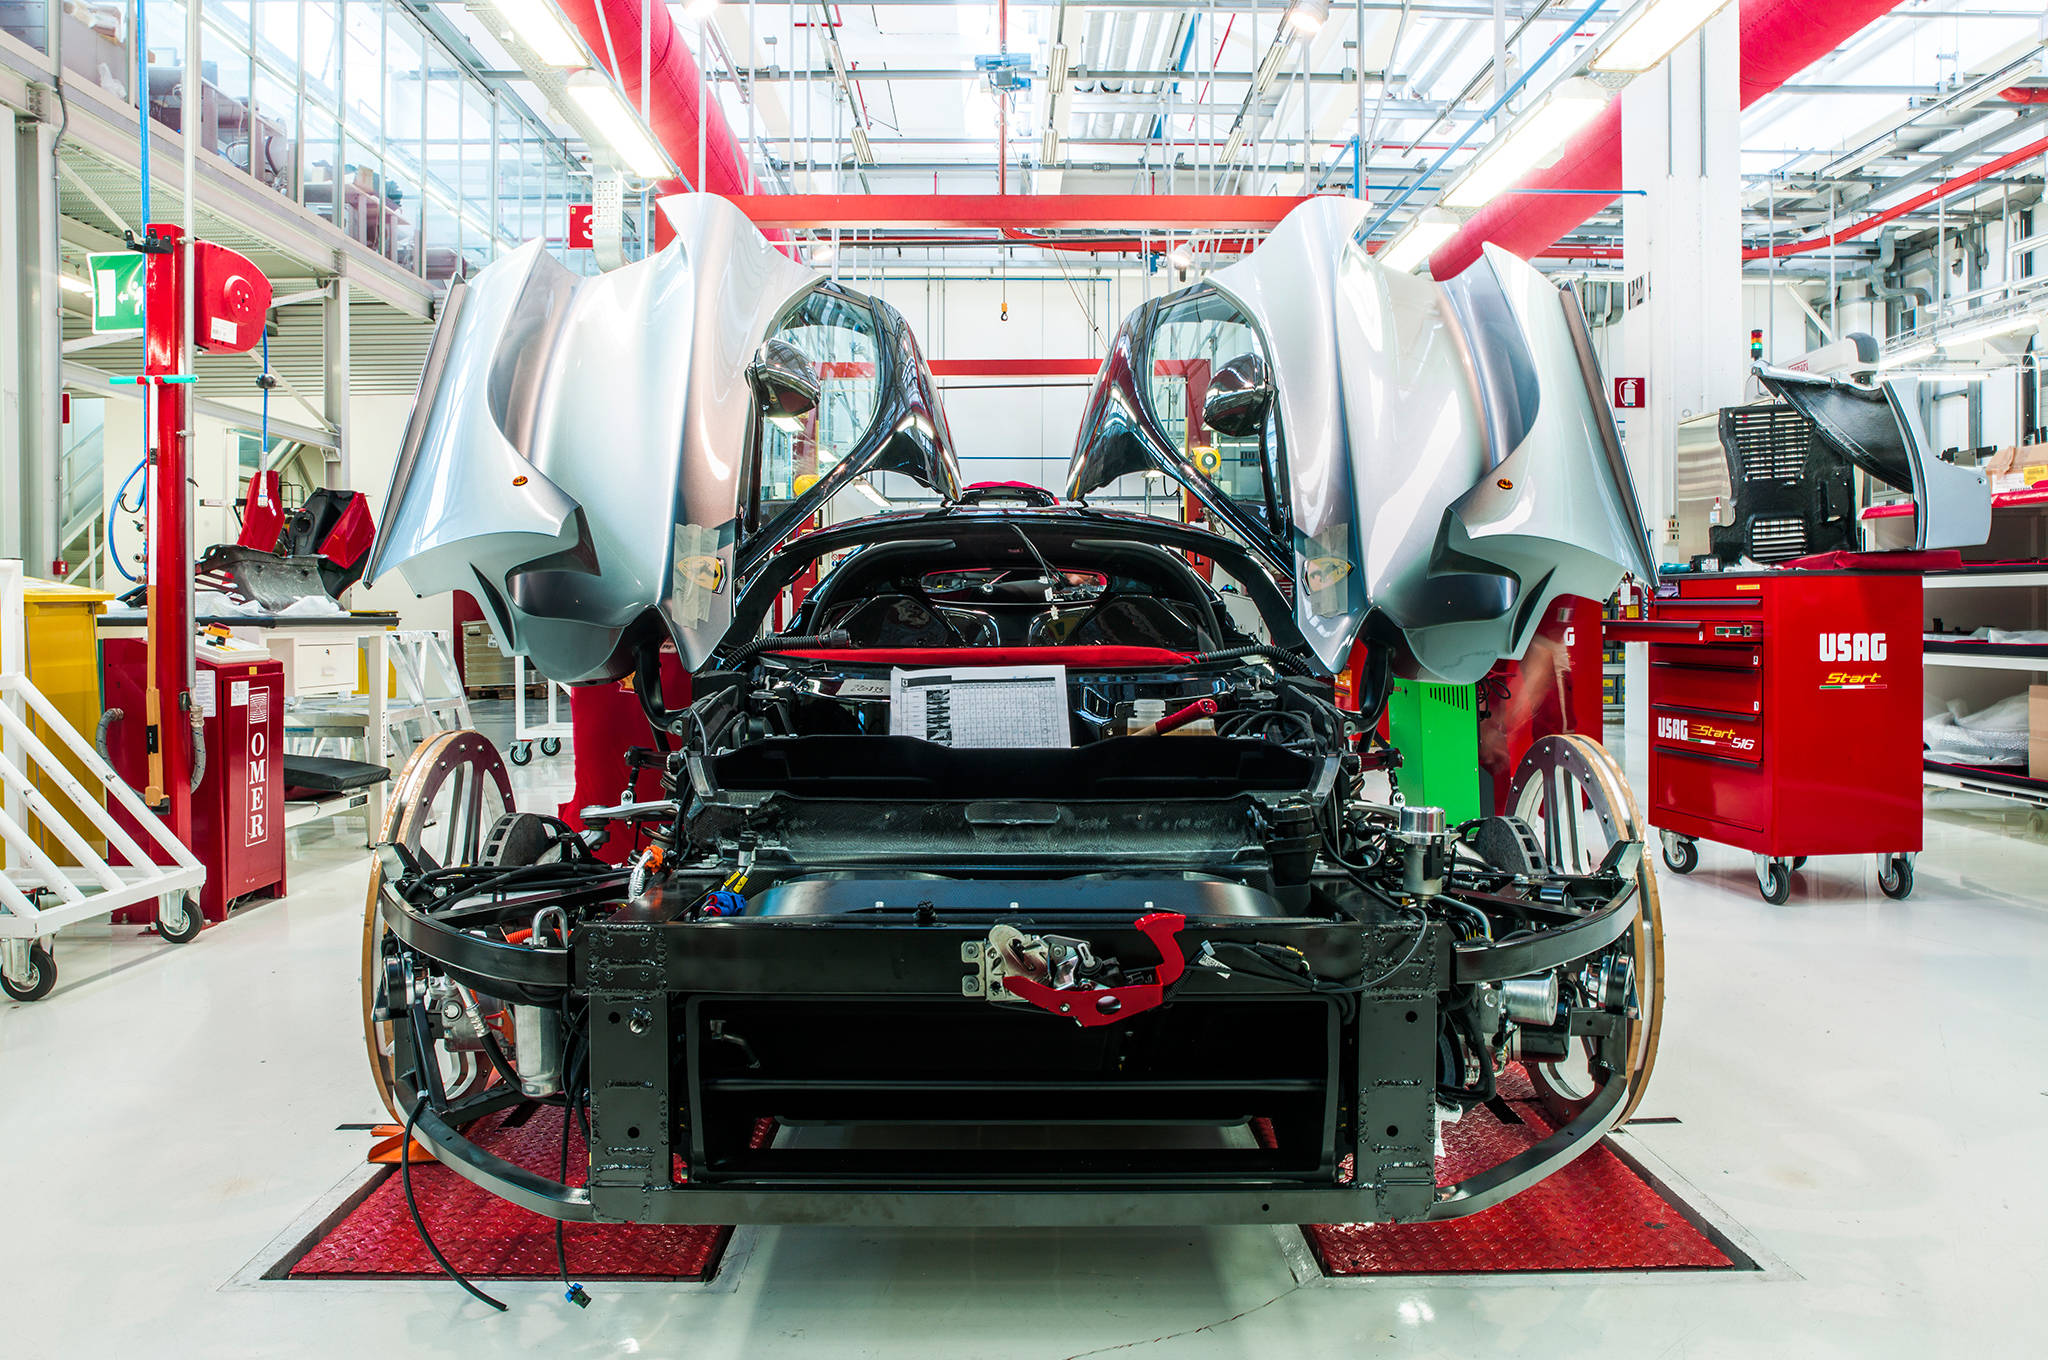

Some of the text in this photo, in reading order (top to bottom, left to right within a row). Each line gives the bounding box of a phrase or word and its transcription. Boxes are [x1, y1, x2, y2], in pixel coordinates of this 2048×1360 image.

[1820, 633, 1887, 661] USAG
[1826, 672, 1881, 683] Start
[1657, 716, 1755, 750] USAG Start 516
[249, 732, 266, 839] OMER
